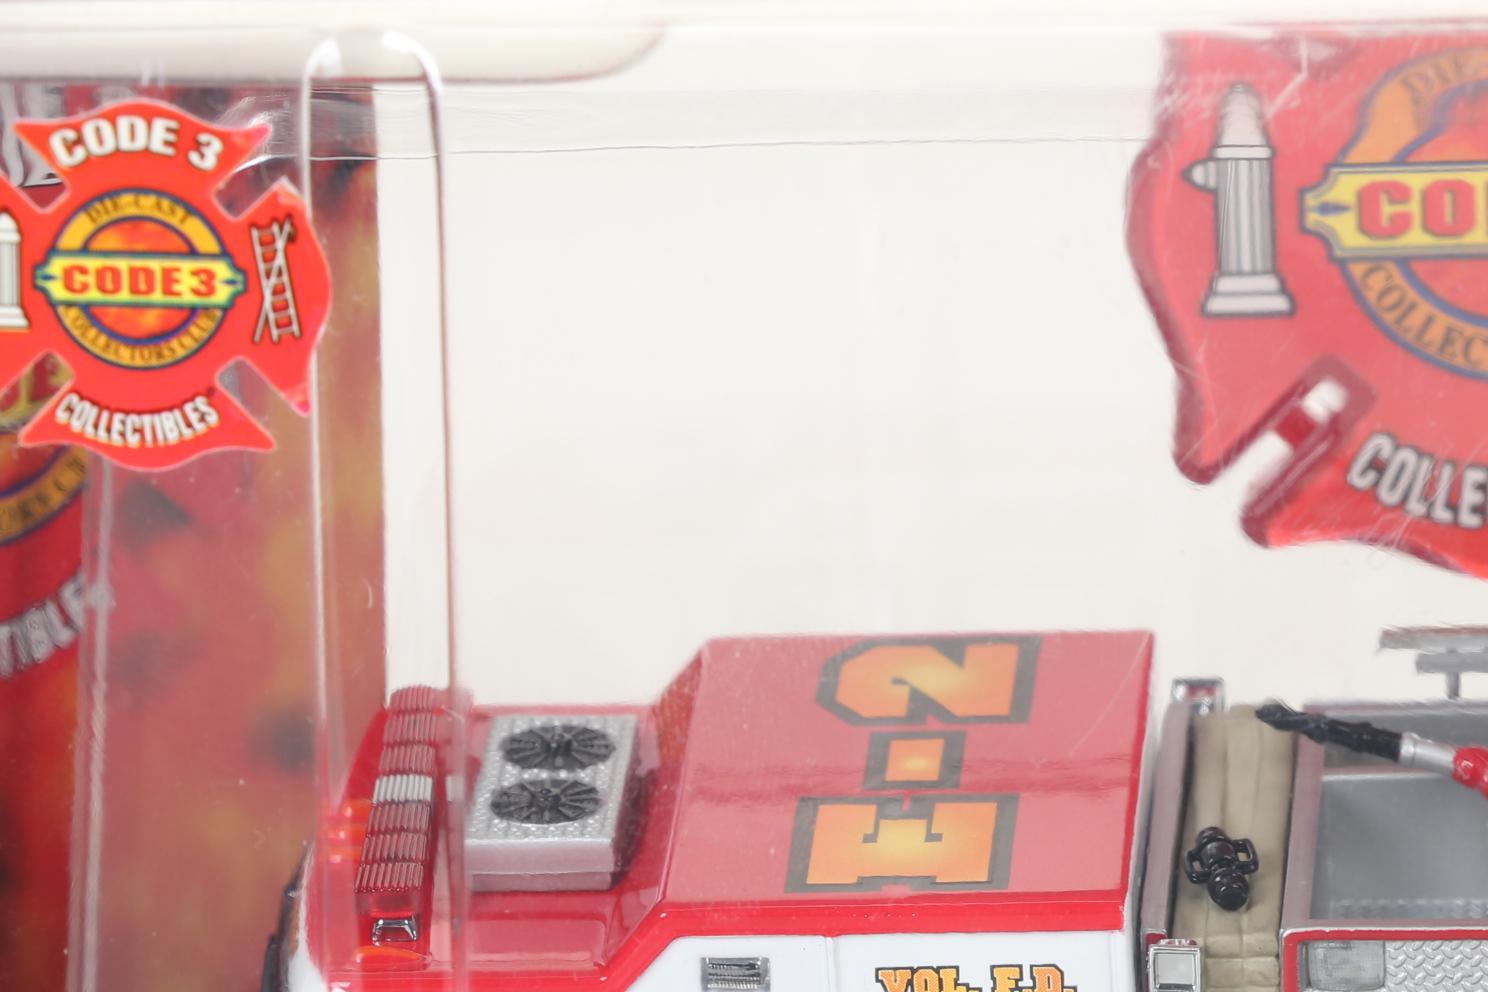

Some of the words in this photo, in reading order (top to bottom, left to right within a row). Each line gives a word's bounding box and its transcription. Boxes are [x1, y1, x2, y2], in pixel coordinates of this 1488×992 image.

[48, 114, 180, 167] CODE
[187, 133, 224, 172] 3
[54, 392, 219, 448] COLLECTIBLES
